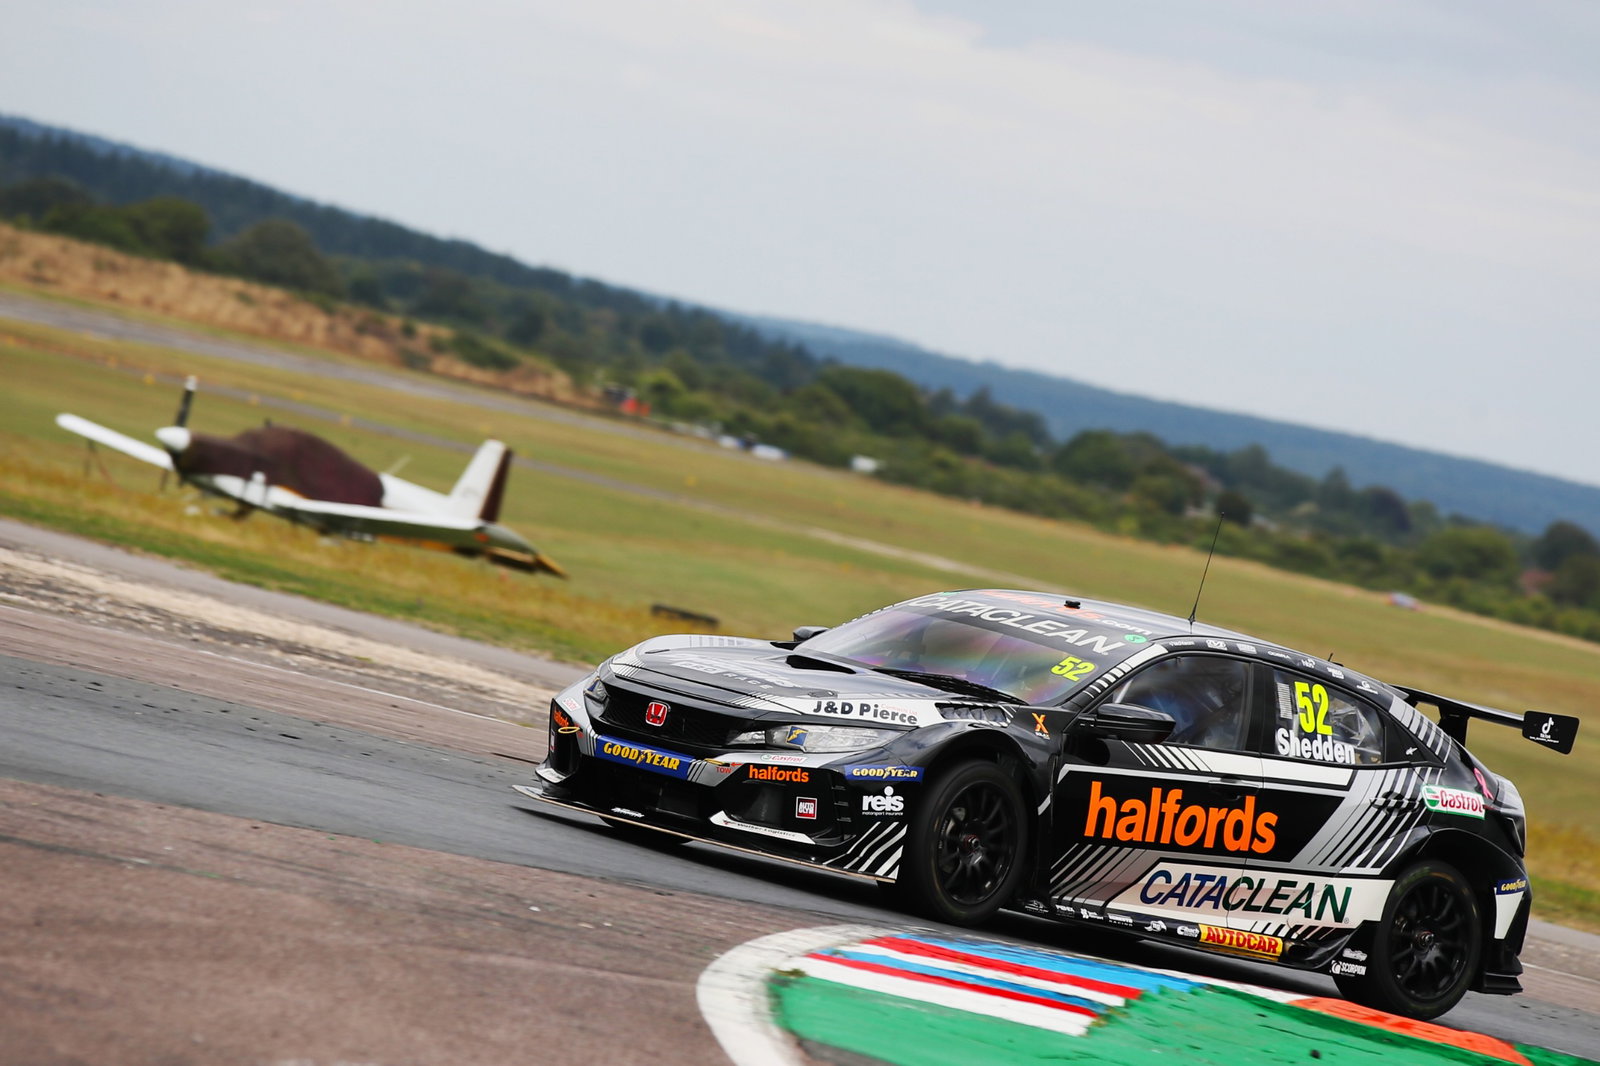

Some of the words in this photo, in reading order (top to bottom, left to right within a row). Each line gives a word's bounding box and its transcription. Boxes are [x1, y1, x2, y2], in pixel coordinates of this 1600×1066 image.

[907, 597, 1126, 654] CATACLEAN
[1051, 656, 1096, 682] 52
[813, 700, 854, 715] J&D
[859, 703, 918, 725] Pierce
[1294, 681, 1333, 736] 52
[1276, 727, 1356, 765] Shedden
[716, 766, 732, 774] TOW
[748, 765, 810, 783] halfords
[862, 786, 904, 812] reis
[1440, 789, 1483, 813] Castrol
[1084, 780, 1279, 854] halfords
[1139, 869, 1353, 924] CATACLEAN
[1205, 926, 1279, 954] AUTOCAR
[1340, 962, 1367, 976] SCORPION
